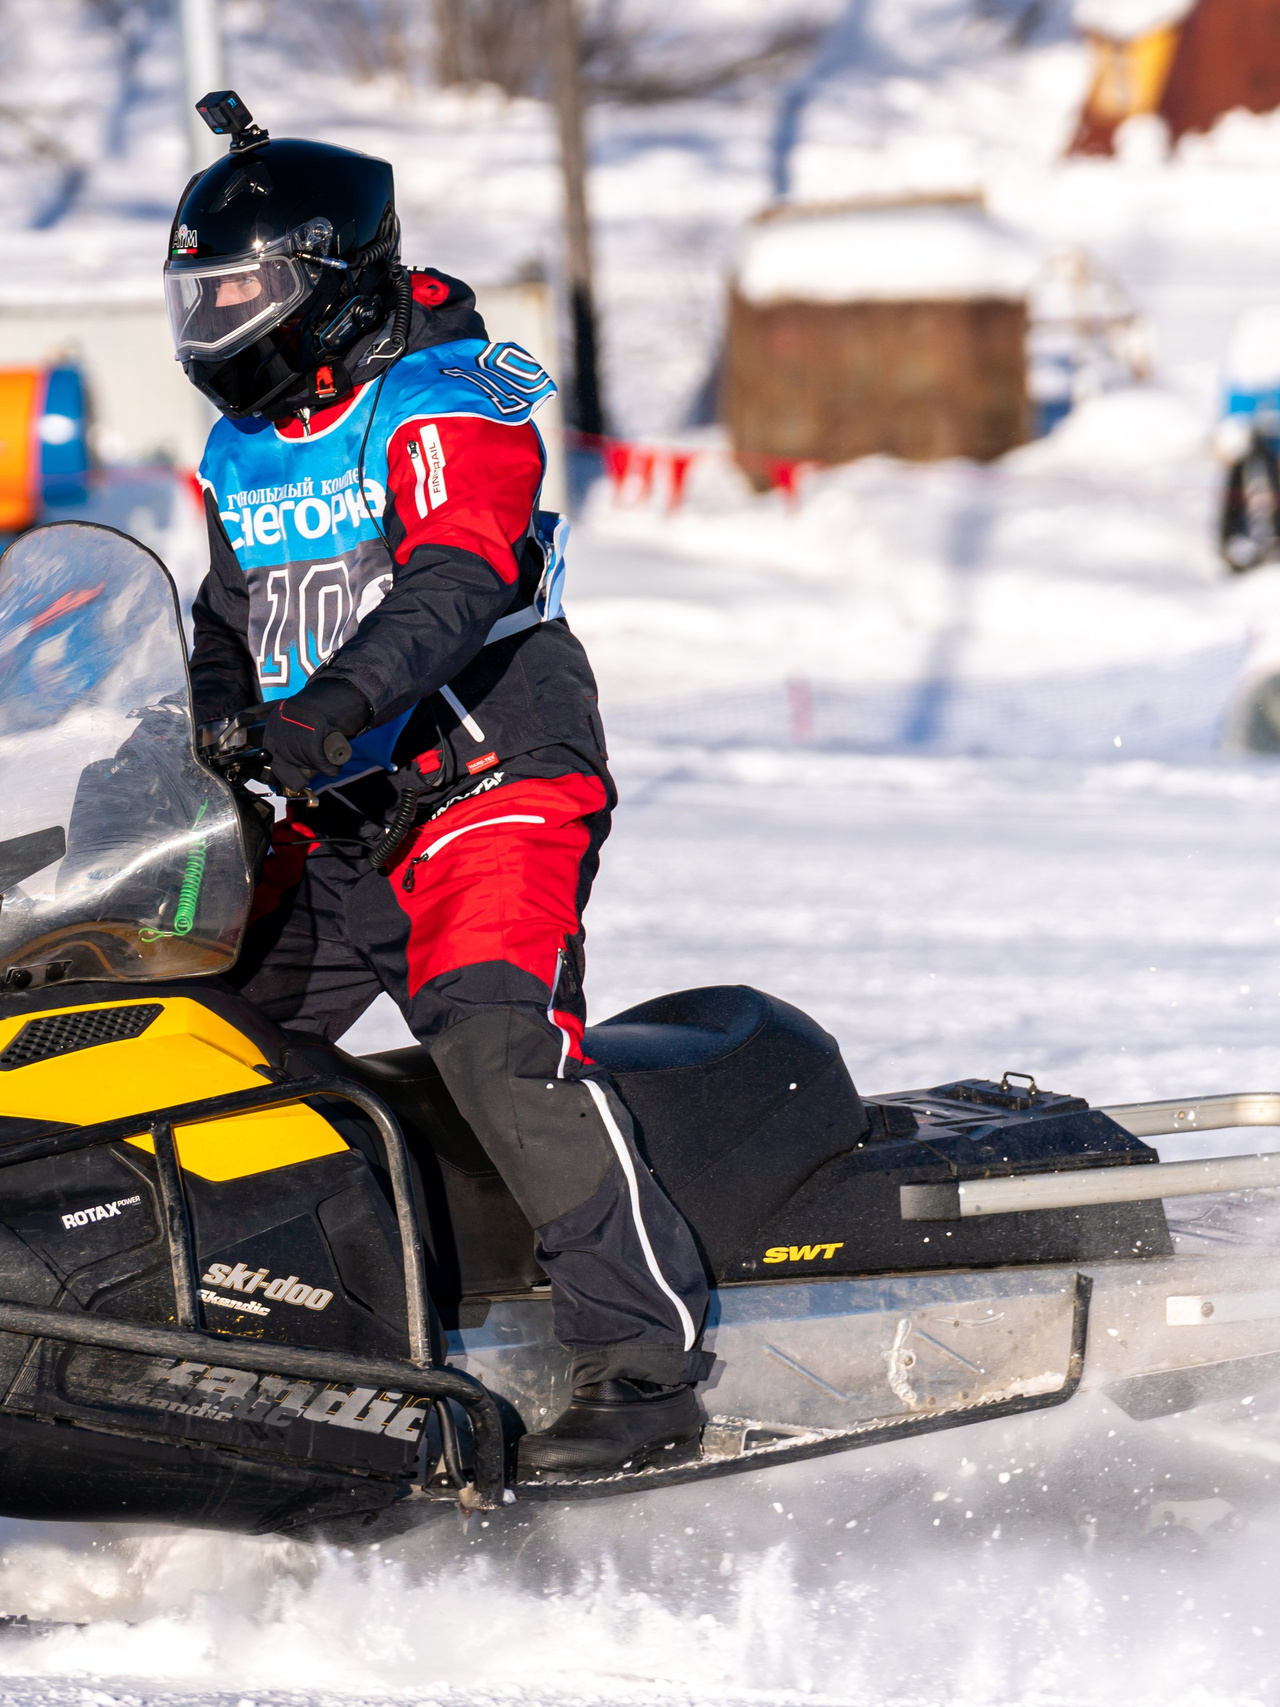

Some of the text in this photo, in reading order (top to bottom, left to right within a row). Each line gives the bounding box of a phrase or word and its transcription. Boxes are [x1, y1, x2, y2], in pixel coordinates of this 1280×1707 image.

[439, 341, 552, 415] 10
[256, 560, 354, 685] 10
[61, 1195, 141, 1230] ROTAX POWER
[762, 1242, 844, 1264] SWT
